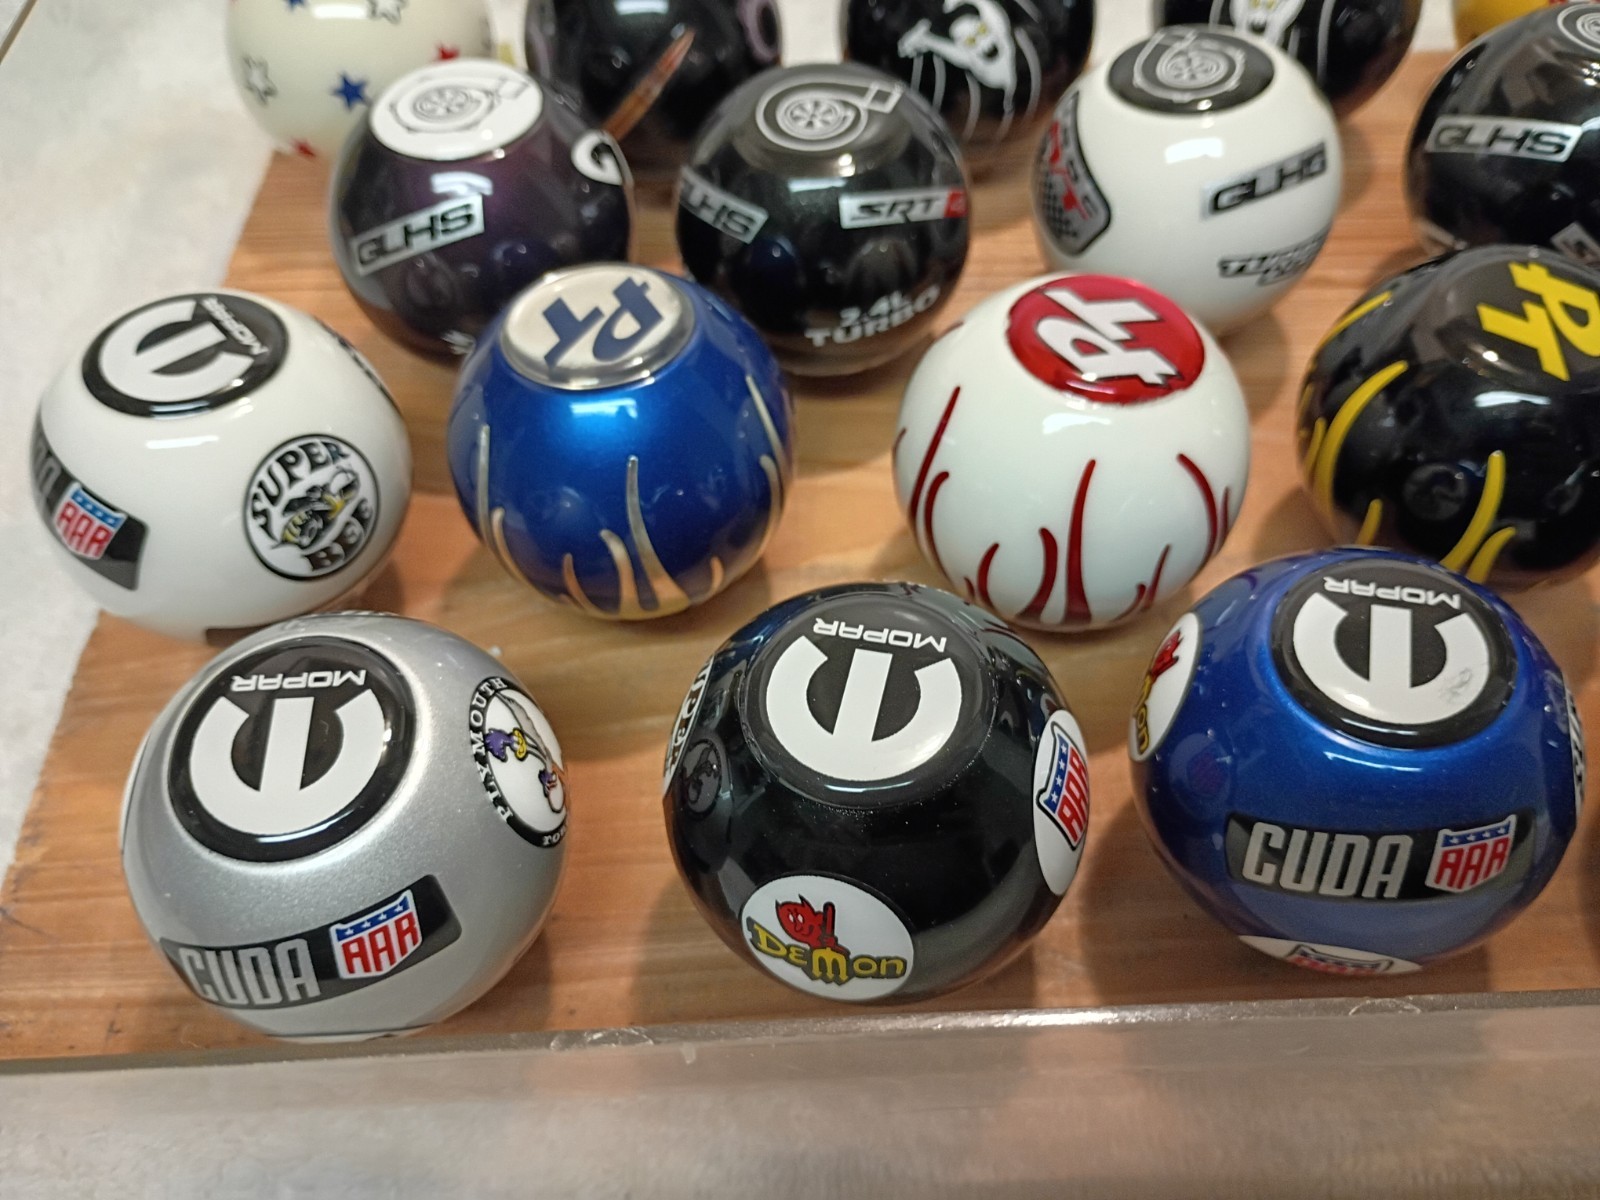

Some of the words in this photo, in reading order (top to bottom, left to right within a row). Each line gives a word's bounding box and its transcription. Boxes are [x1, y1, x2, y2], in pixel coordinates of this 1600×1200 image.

[202, 296, 268, 354] MOPAR
[803, 285, 939, 347] TURBO
[252, 442, 350, 541] SUPER
[304, 498, 374, 571] BEE
[1323, 576, 1460, 610] MOPAR
[813, 618, 947, 652] MOPAR
[231, 669, 366, 692] MOPAR
[469, 677, 513, 822] PLYMOUTH
[1242, 821, 1413, 899] CUDA
[1434, 836, 1510, 889] AAR
[178, 938, 321, 1005] CUDA
[342, 910, 420, 974] AAR
